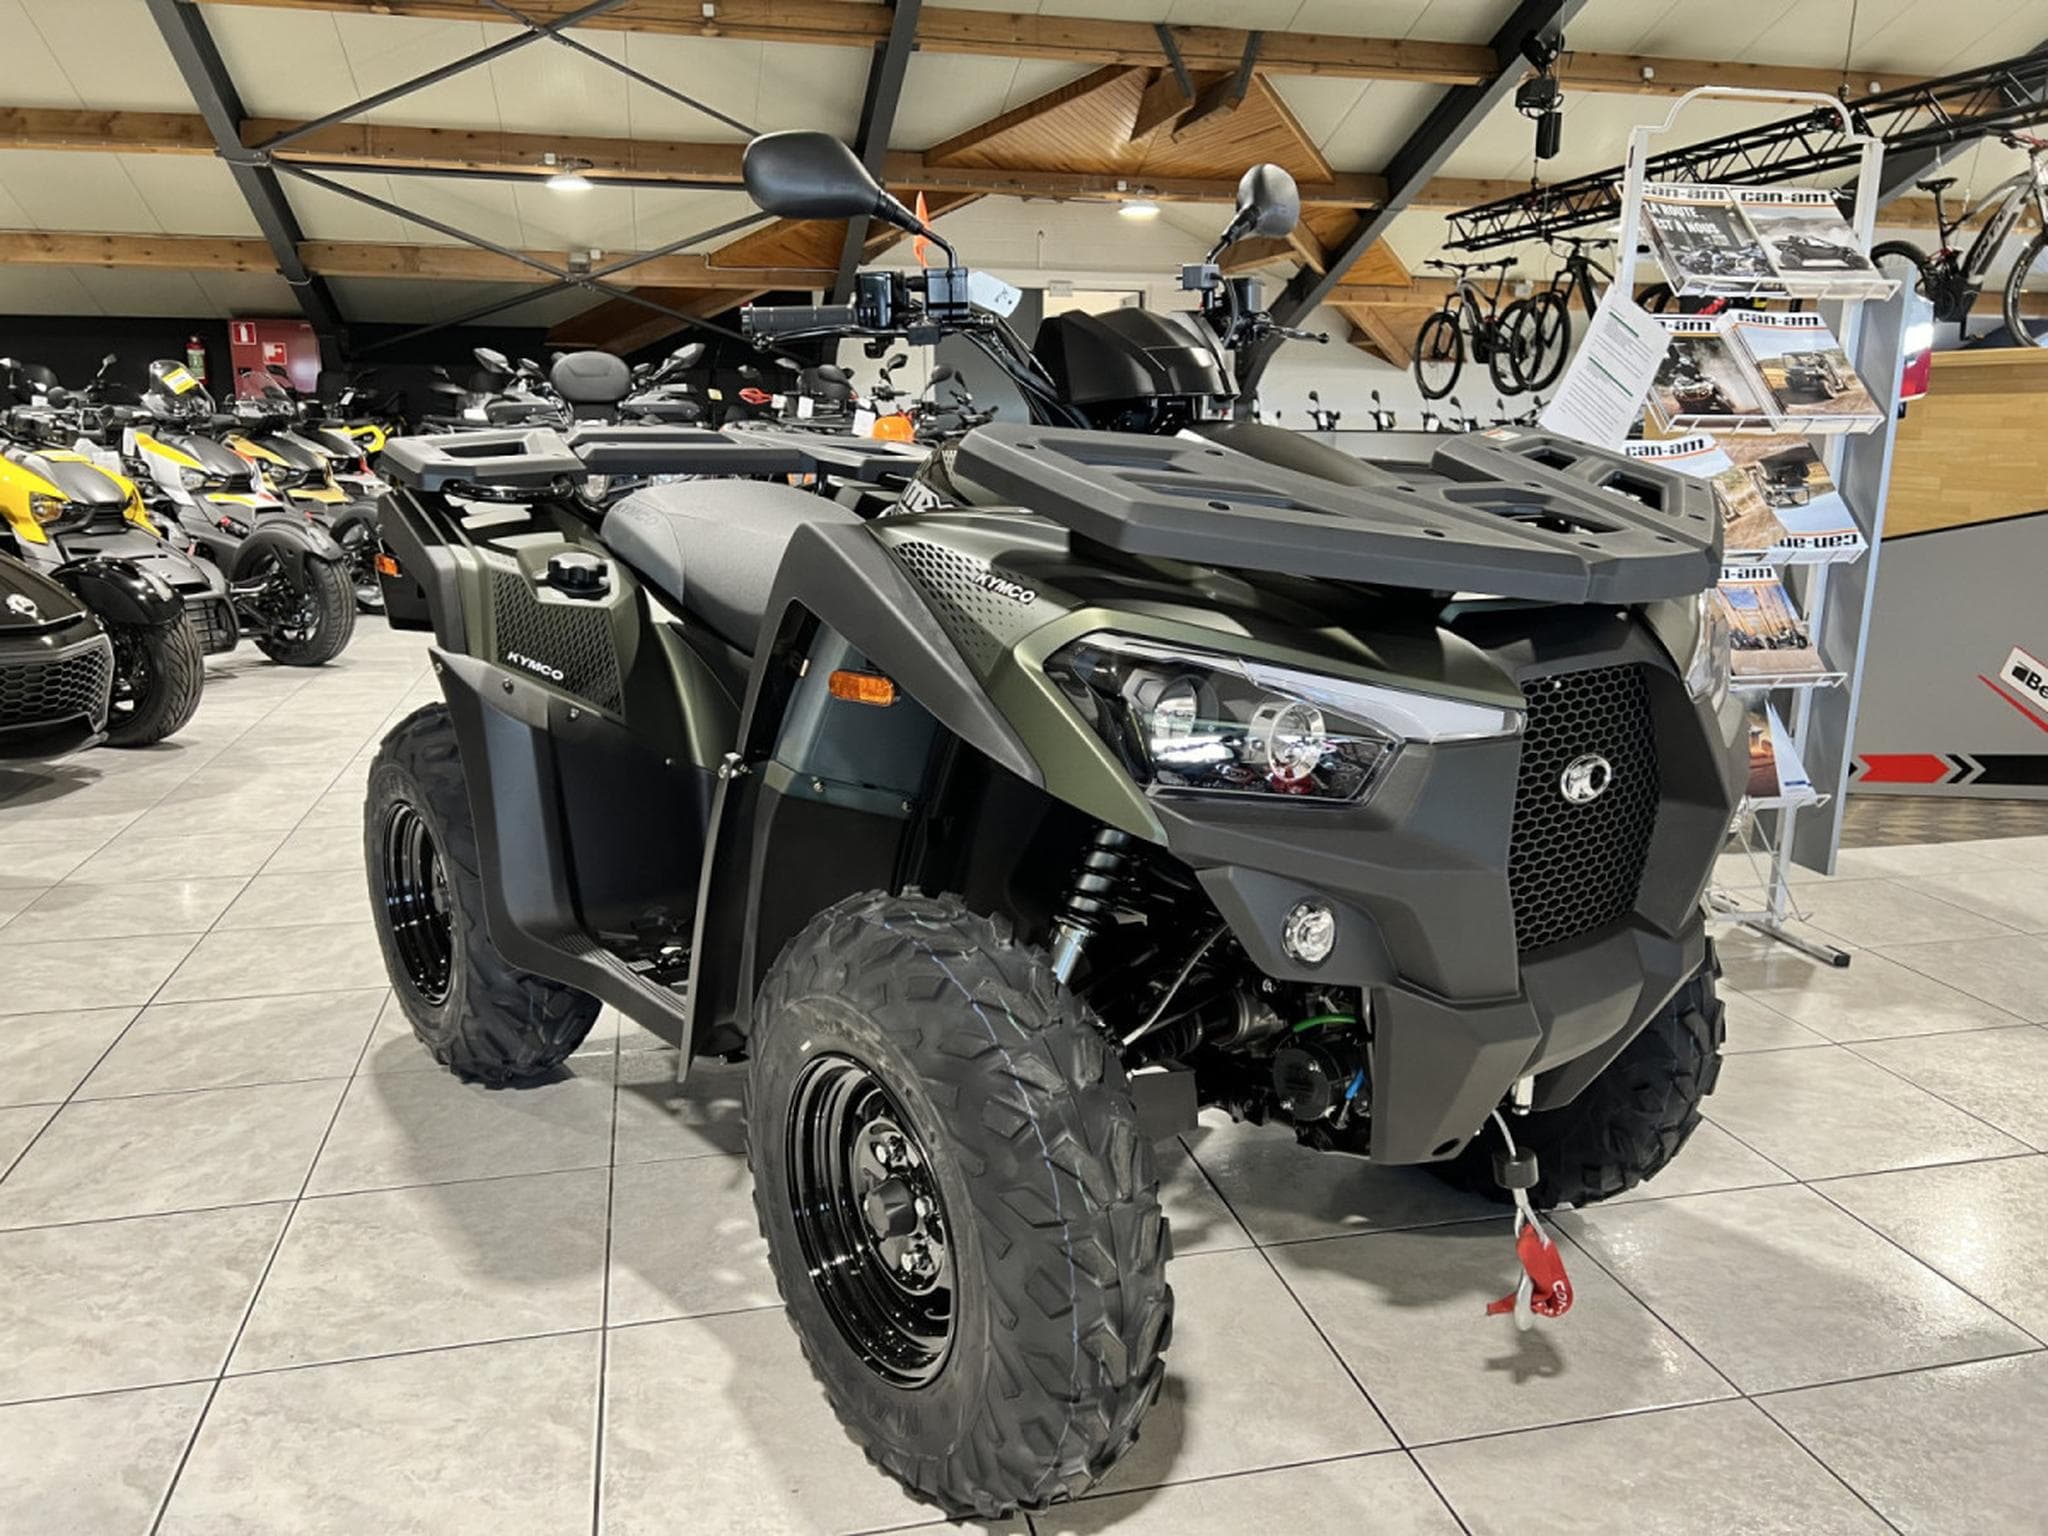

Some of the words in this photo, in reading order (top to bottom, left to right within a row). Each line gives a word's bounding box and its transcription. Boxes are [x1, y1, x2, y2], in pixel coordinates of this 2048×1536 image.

[1740, 192, 1827, 203] can-am
[1738, 313, 1819, 326] can-am
[1625, 438, 1704, 456] can-am
[975, 570, 1037, 604] KYMCO
[506, 650, 564, 681] KYMCO
